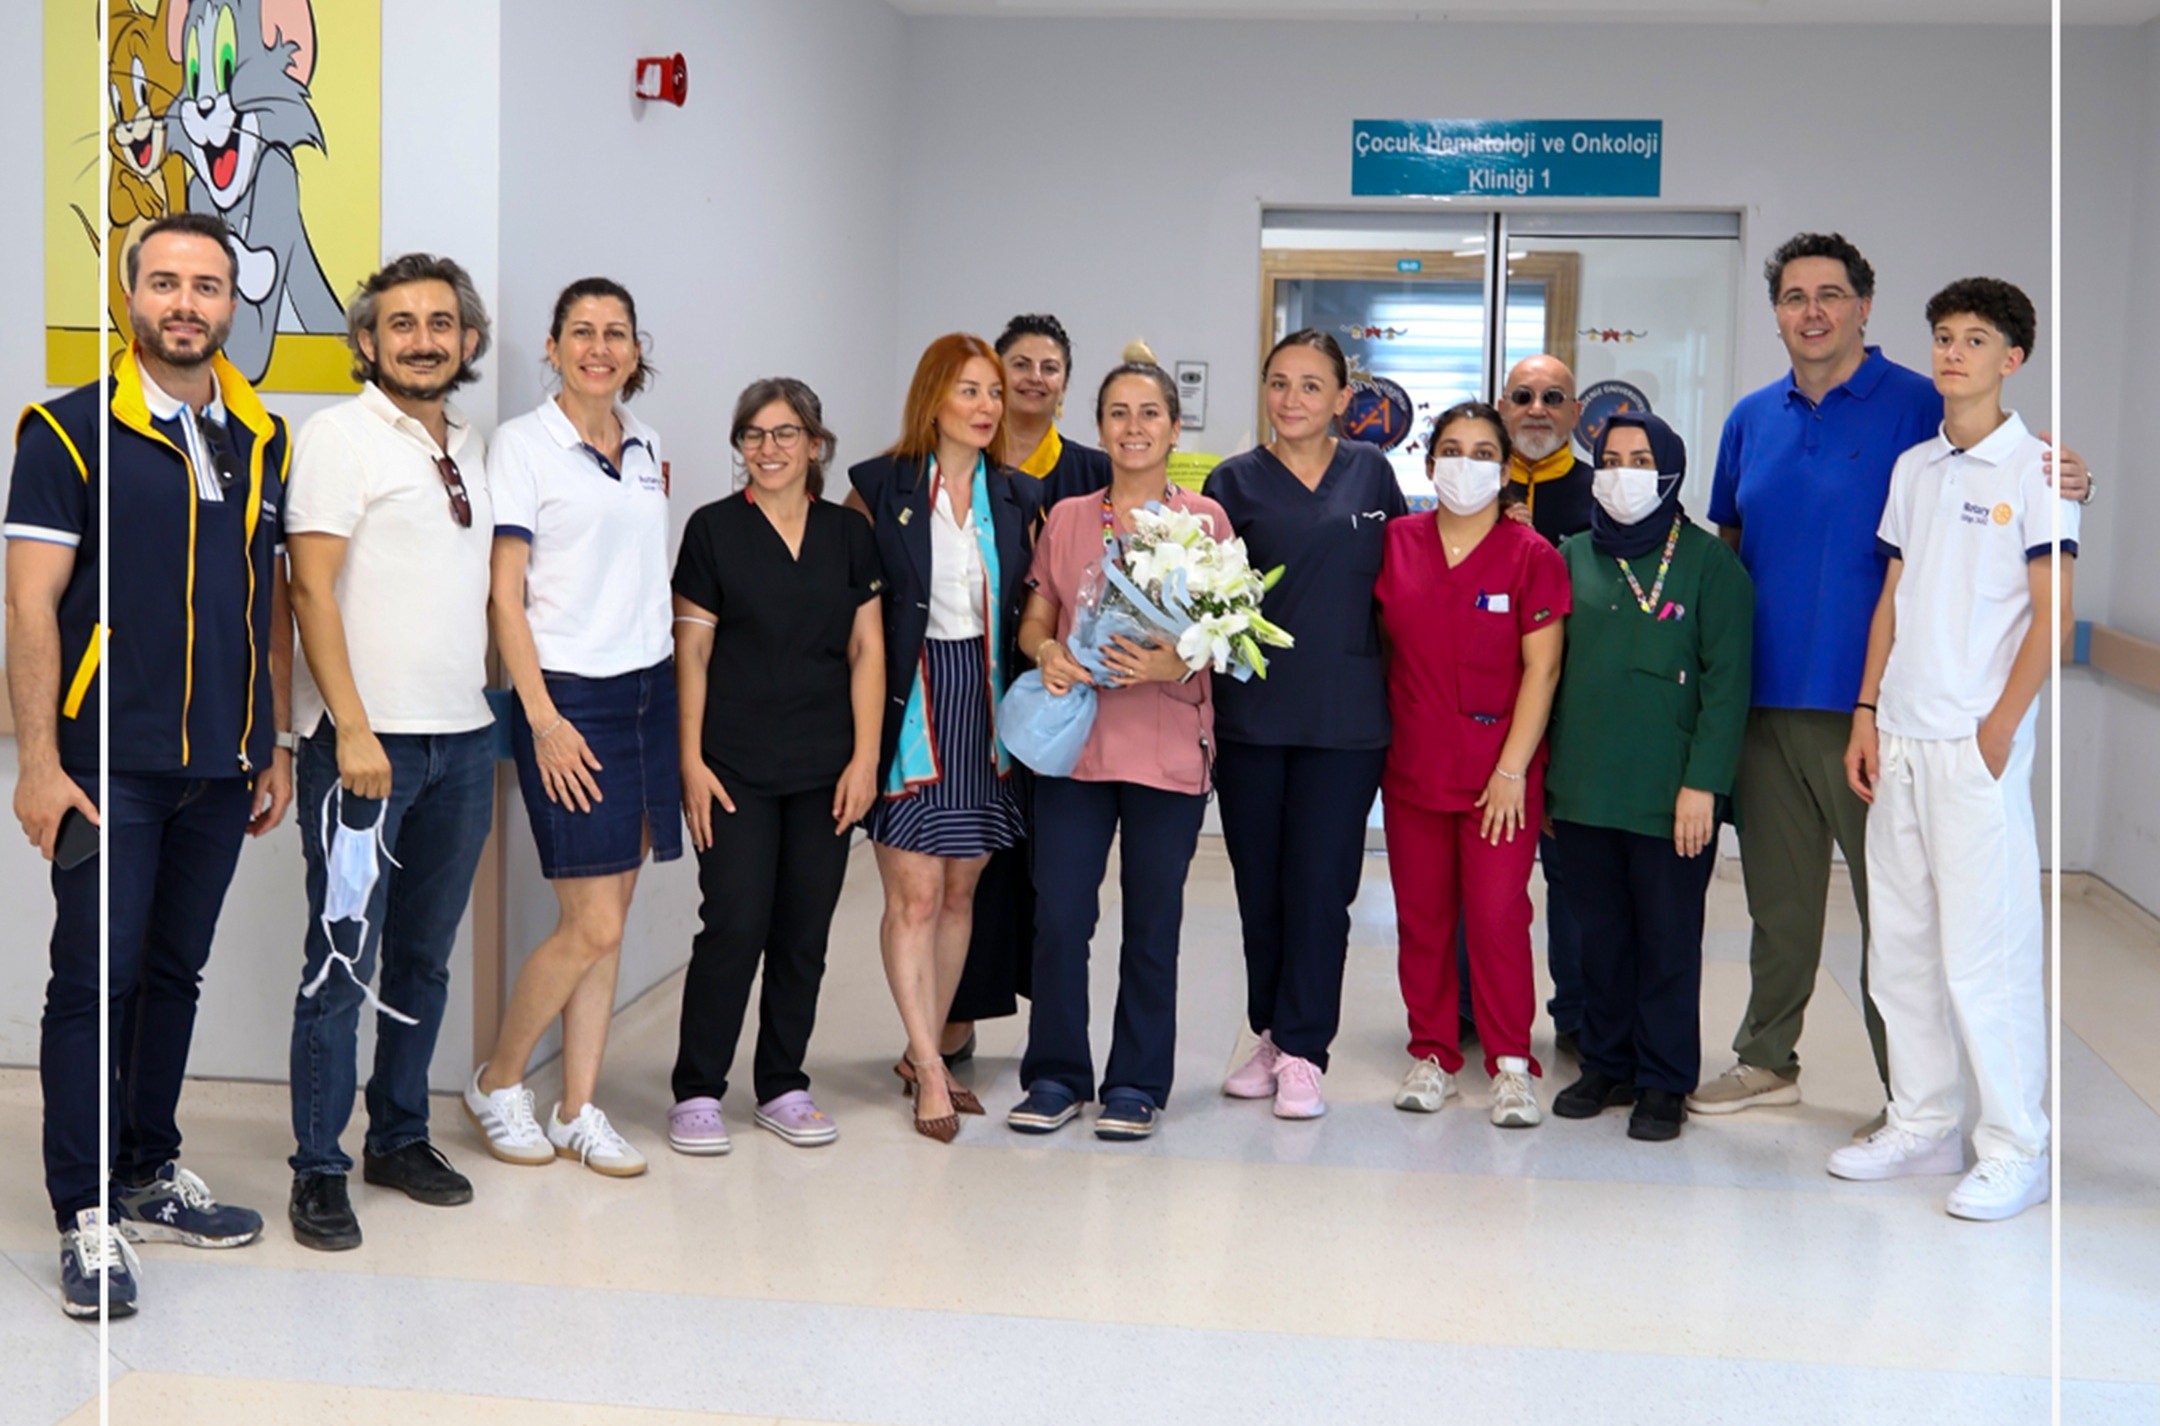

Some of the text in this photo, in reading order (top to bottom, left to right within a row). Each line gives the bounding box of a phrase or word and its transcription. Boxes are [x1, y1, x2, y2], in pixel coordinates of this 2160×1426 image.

[1355, 131, 1658, 159] Çocuk Hematoloji ve Onkoloji
[1468, 168, 1550, 194] Kliniği 1
